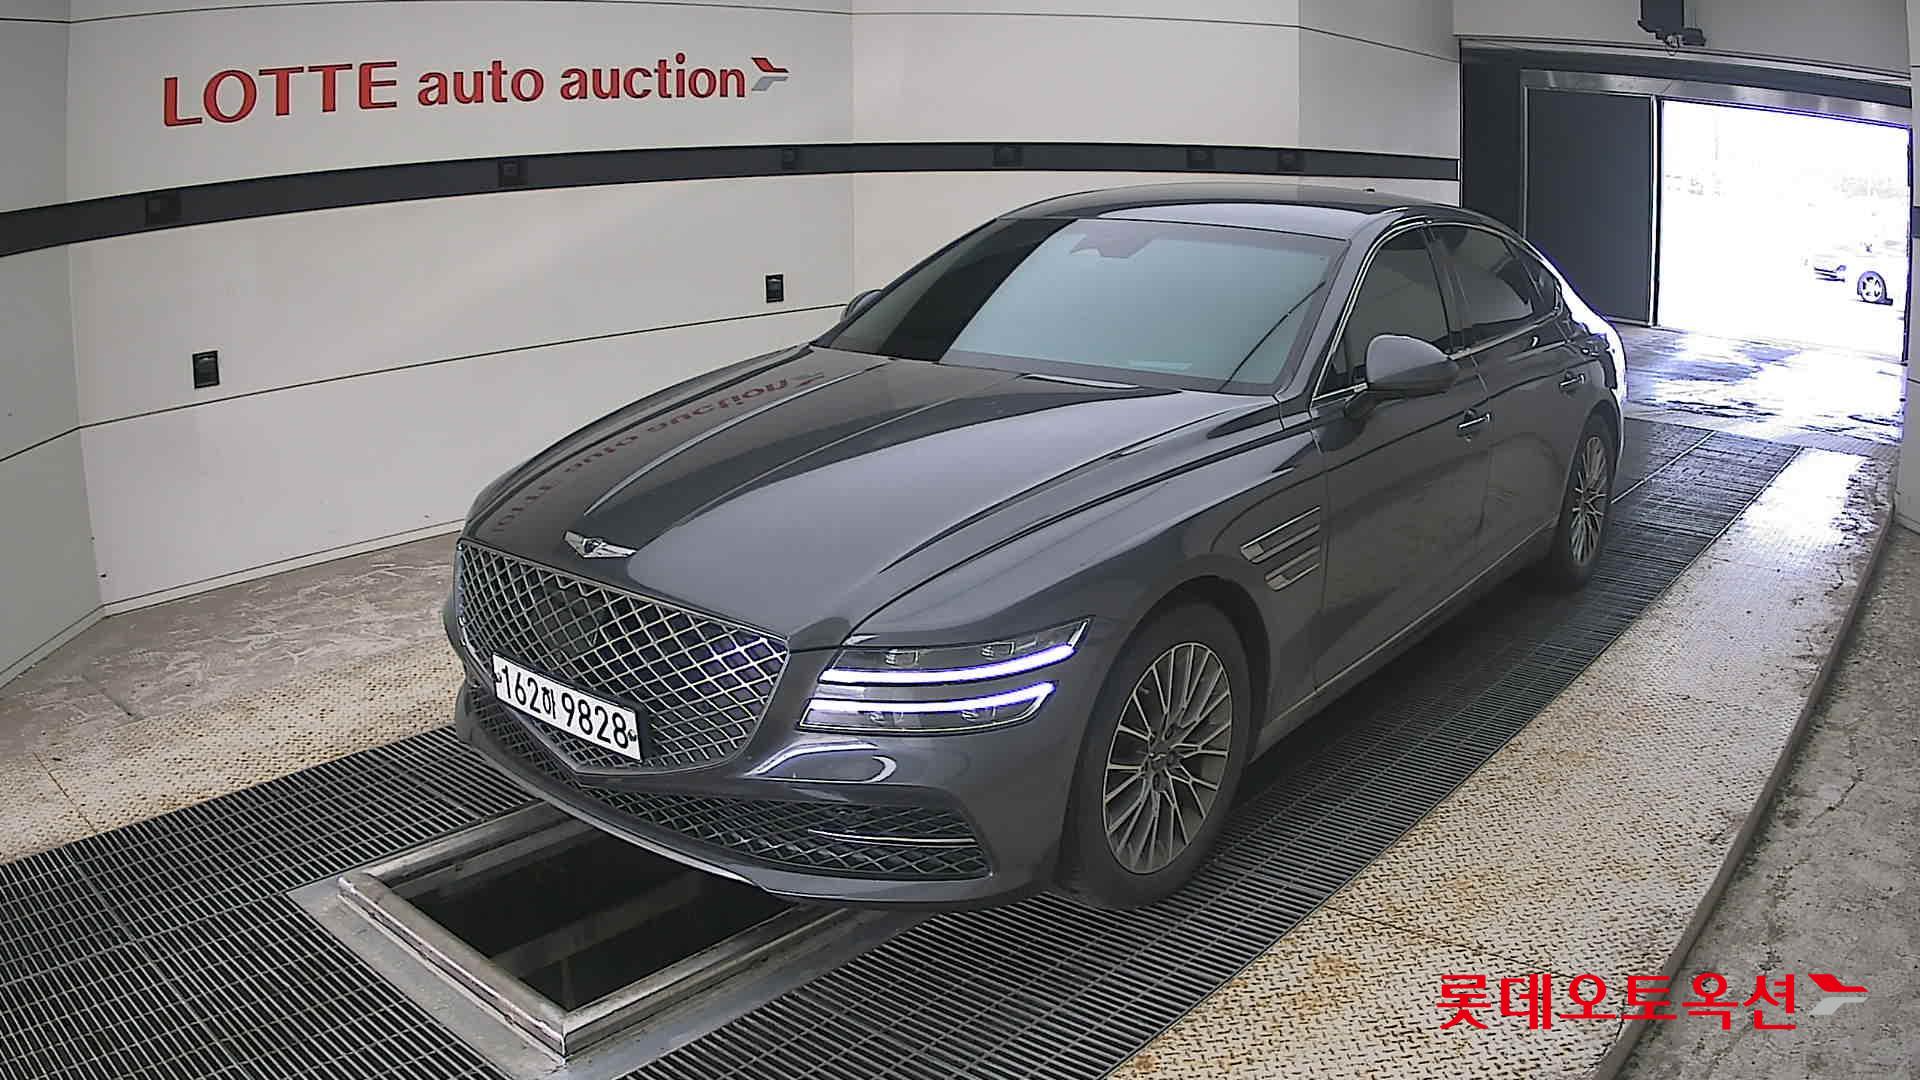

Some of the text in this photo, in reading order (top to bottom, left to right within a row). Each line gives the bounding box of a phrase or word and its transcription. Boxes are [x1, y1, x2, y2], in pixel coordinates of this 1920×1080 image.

[162, 52, 749, 128] LOTTE auto auction
[561, 692, 630, 750] 9828
